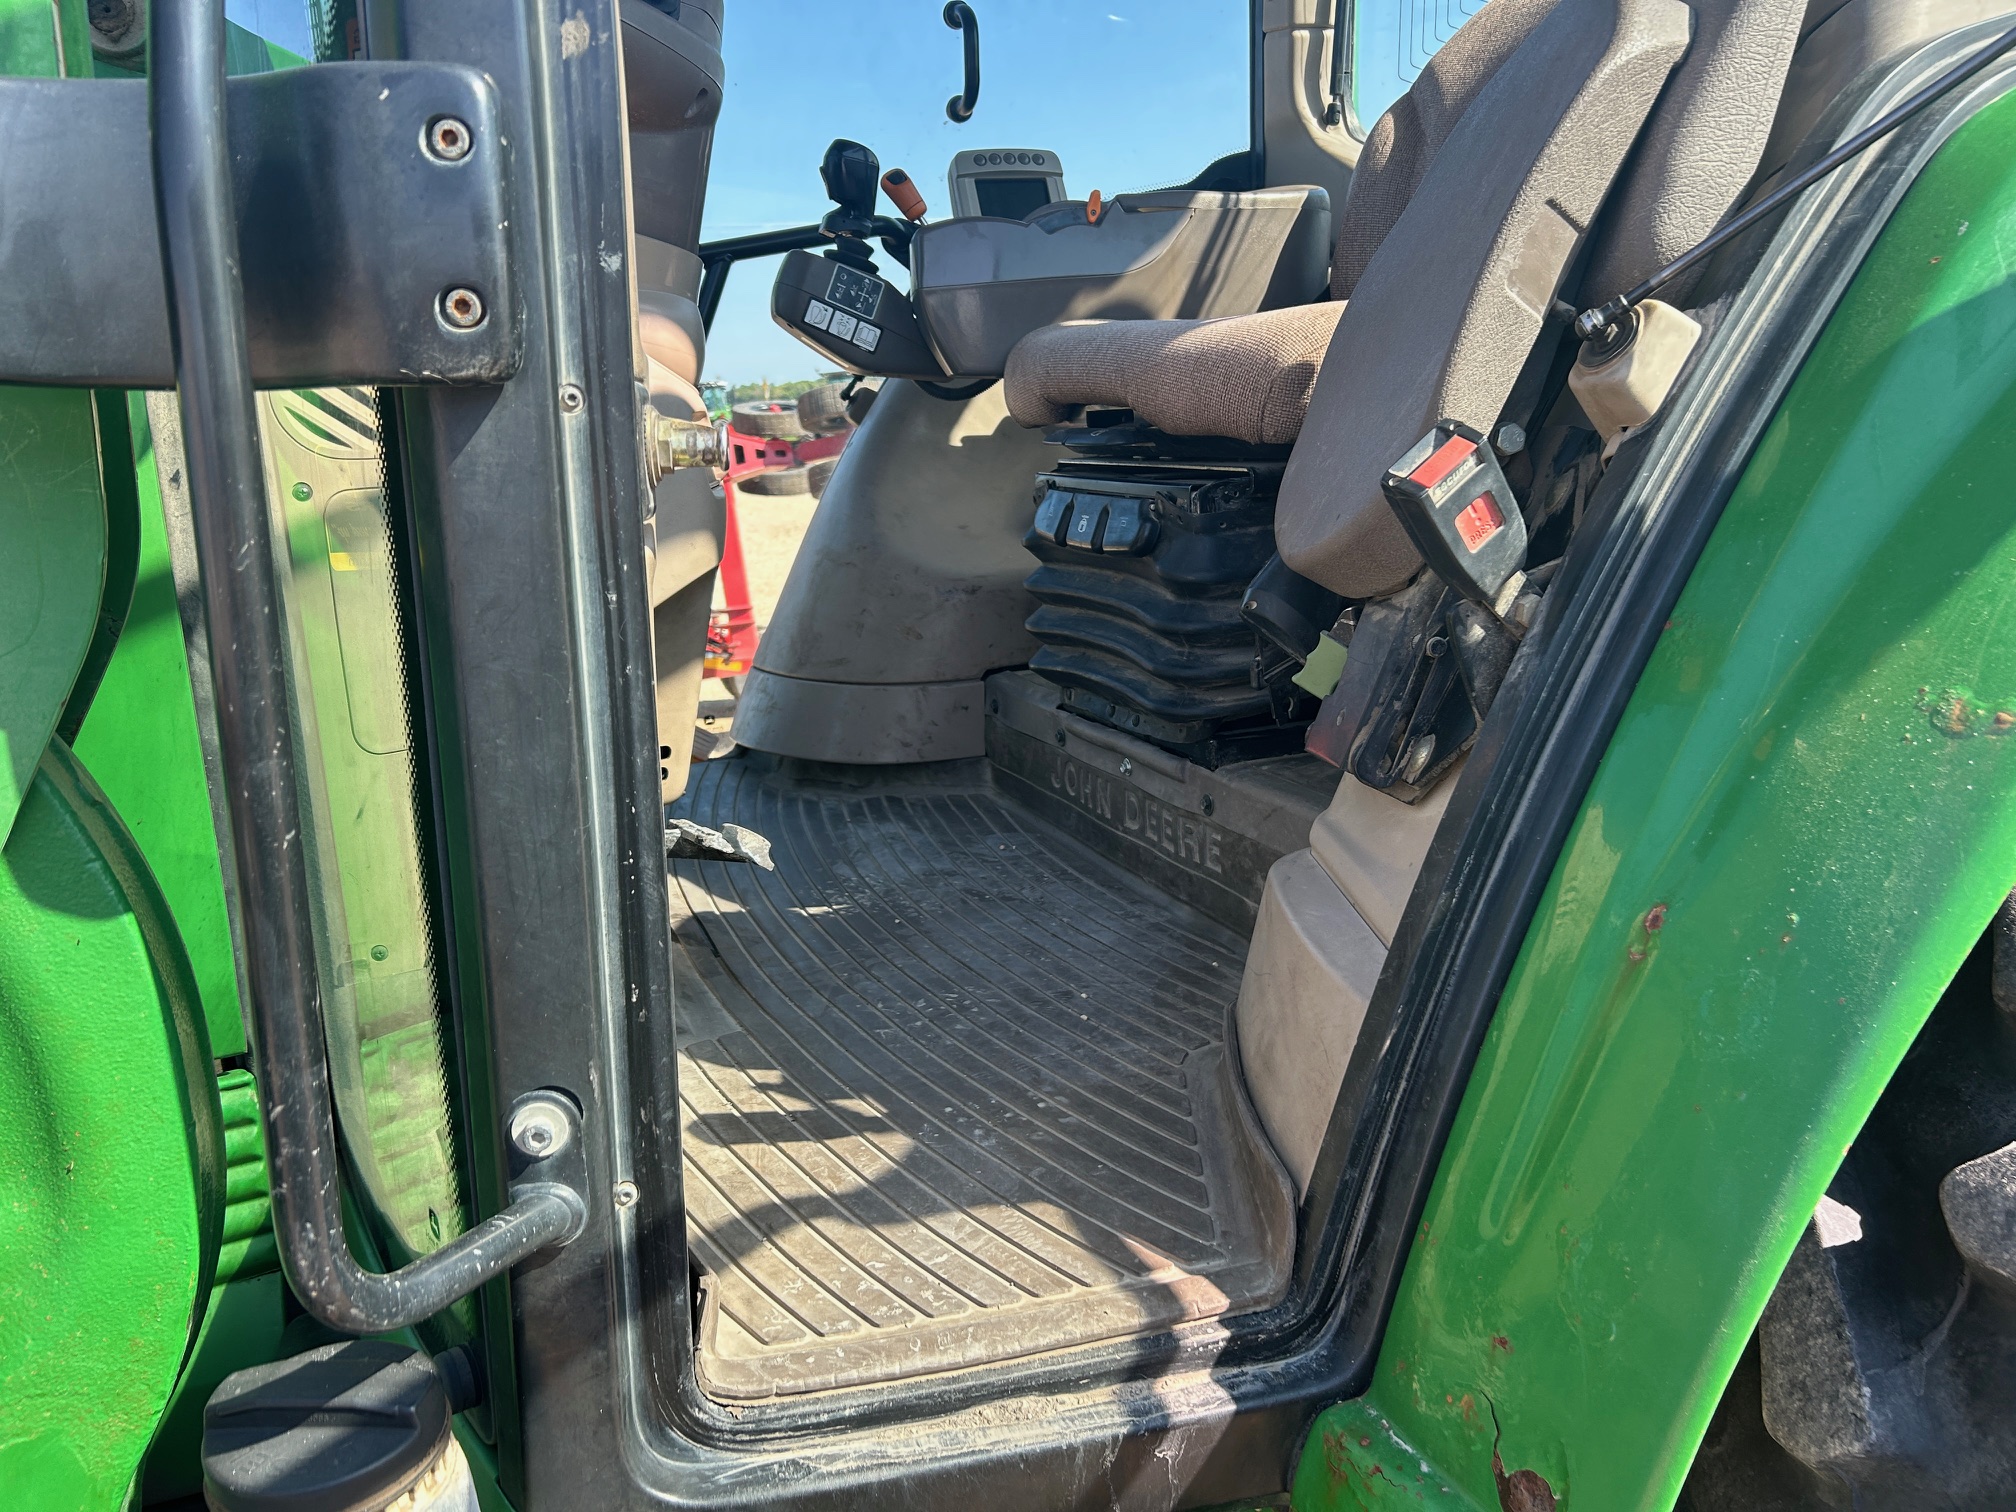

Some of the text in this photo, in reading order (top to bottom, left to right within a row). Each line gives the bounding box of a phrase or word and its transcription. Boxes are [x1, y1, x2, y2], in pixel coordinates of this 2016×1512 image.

[1434, 453, 1476, 494] securo
[1051, 755, 1222, 874] JOHN DEERE
